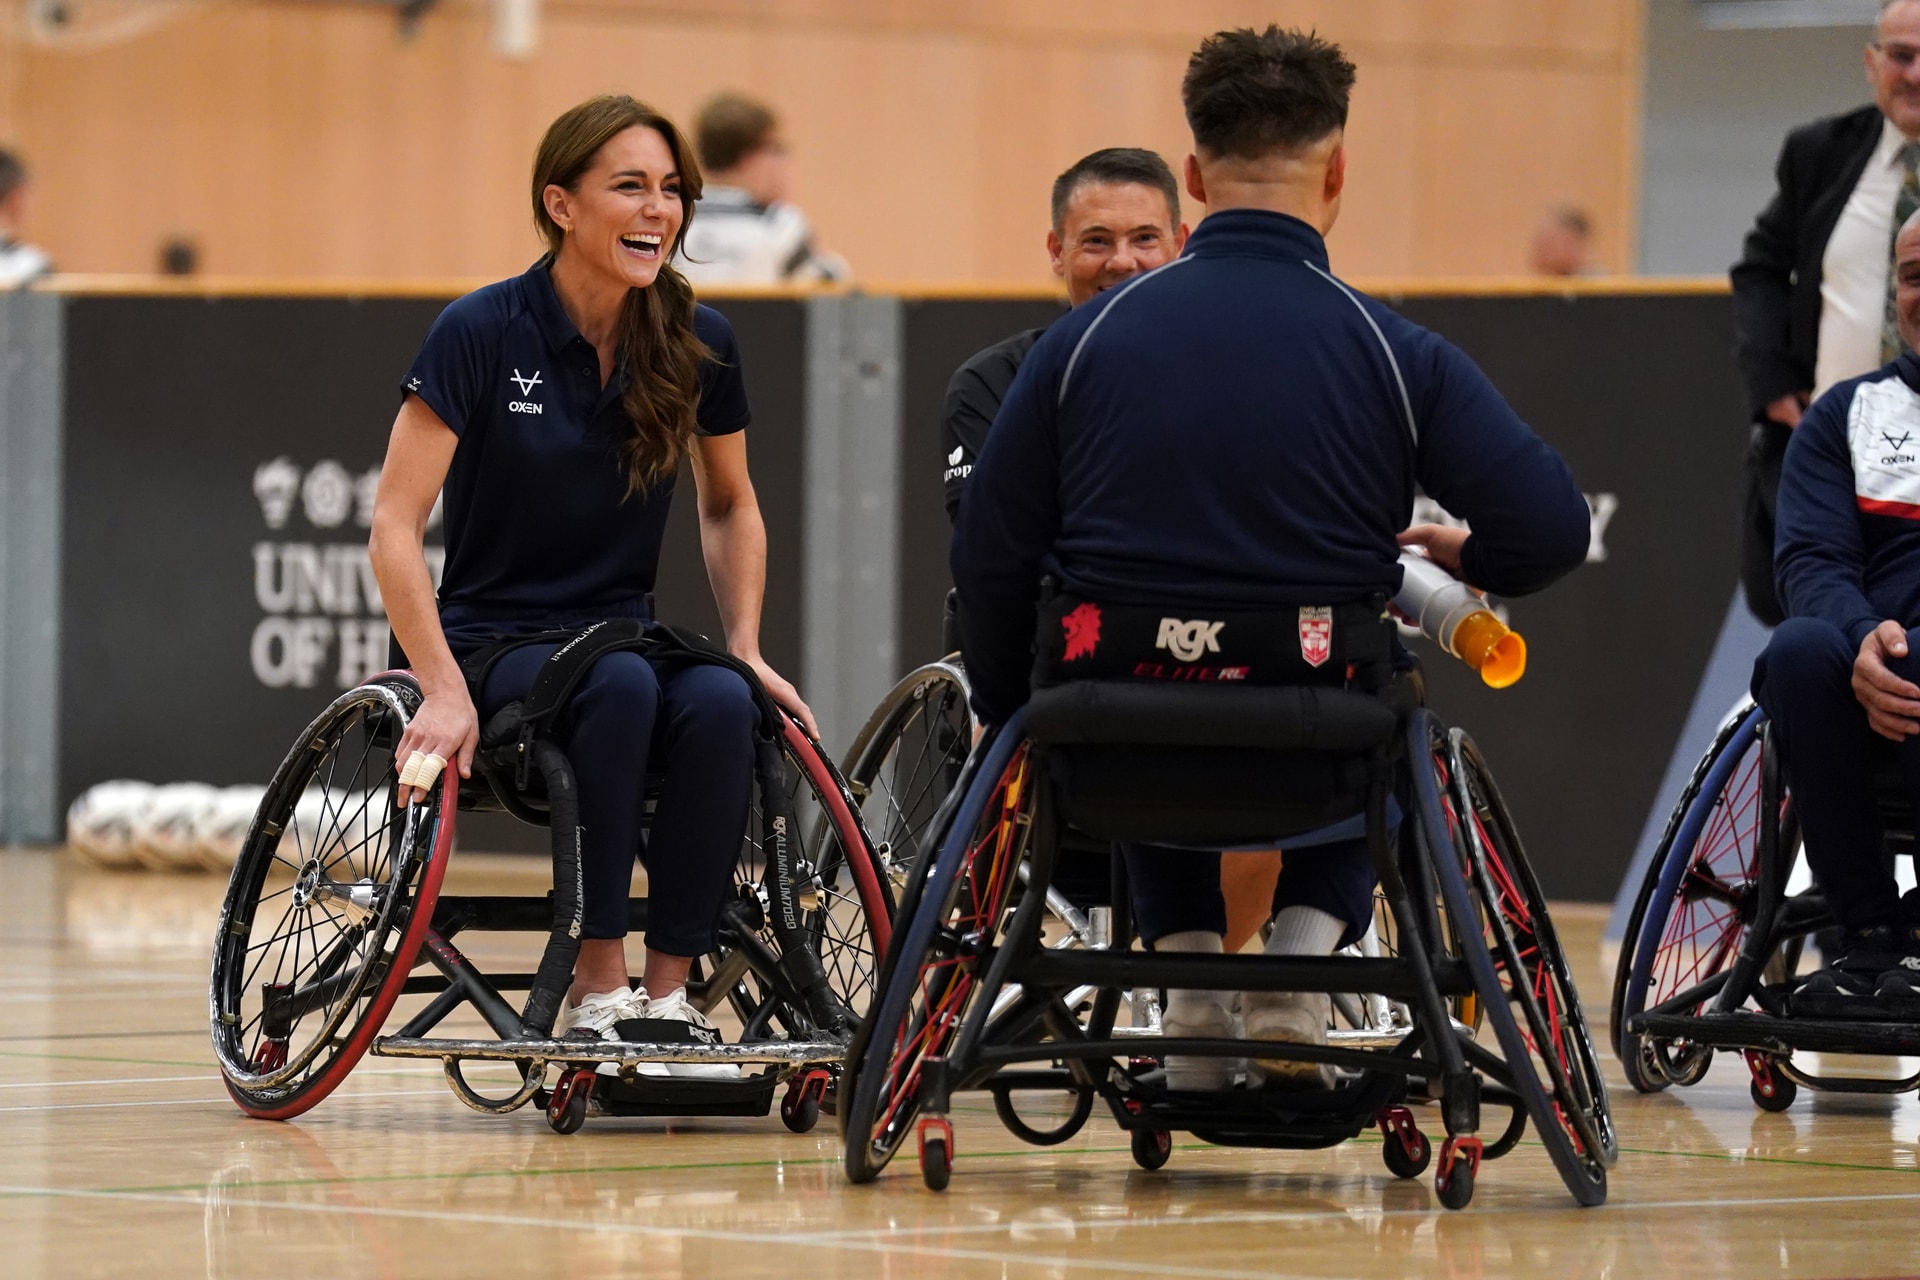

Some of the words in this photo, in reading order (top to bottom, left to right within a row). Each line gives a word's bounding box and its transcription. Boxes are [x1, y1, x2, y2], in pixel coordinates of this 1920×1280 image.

[508, 401, 543, 415] OXEN
[1881, 455, 1915, 465] OXEN
[251, 616, 334, 689] OF
